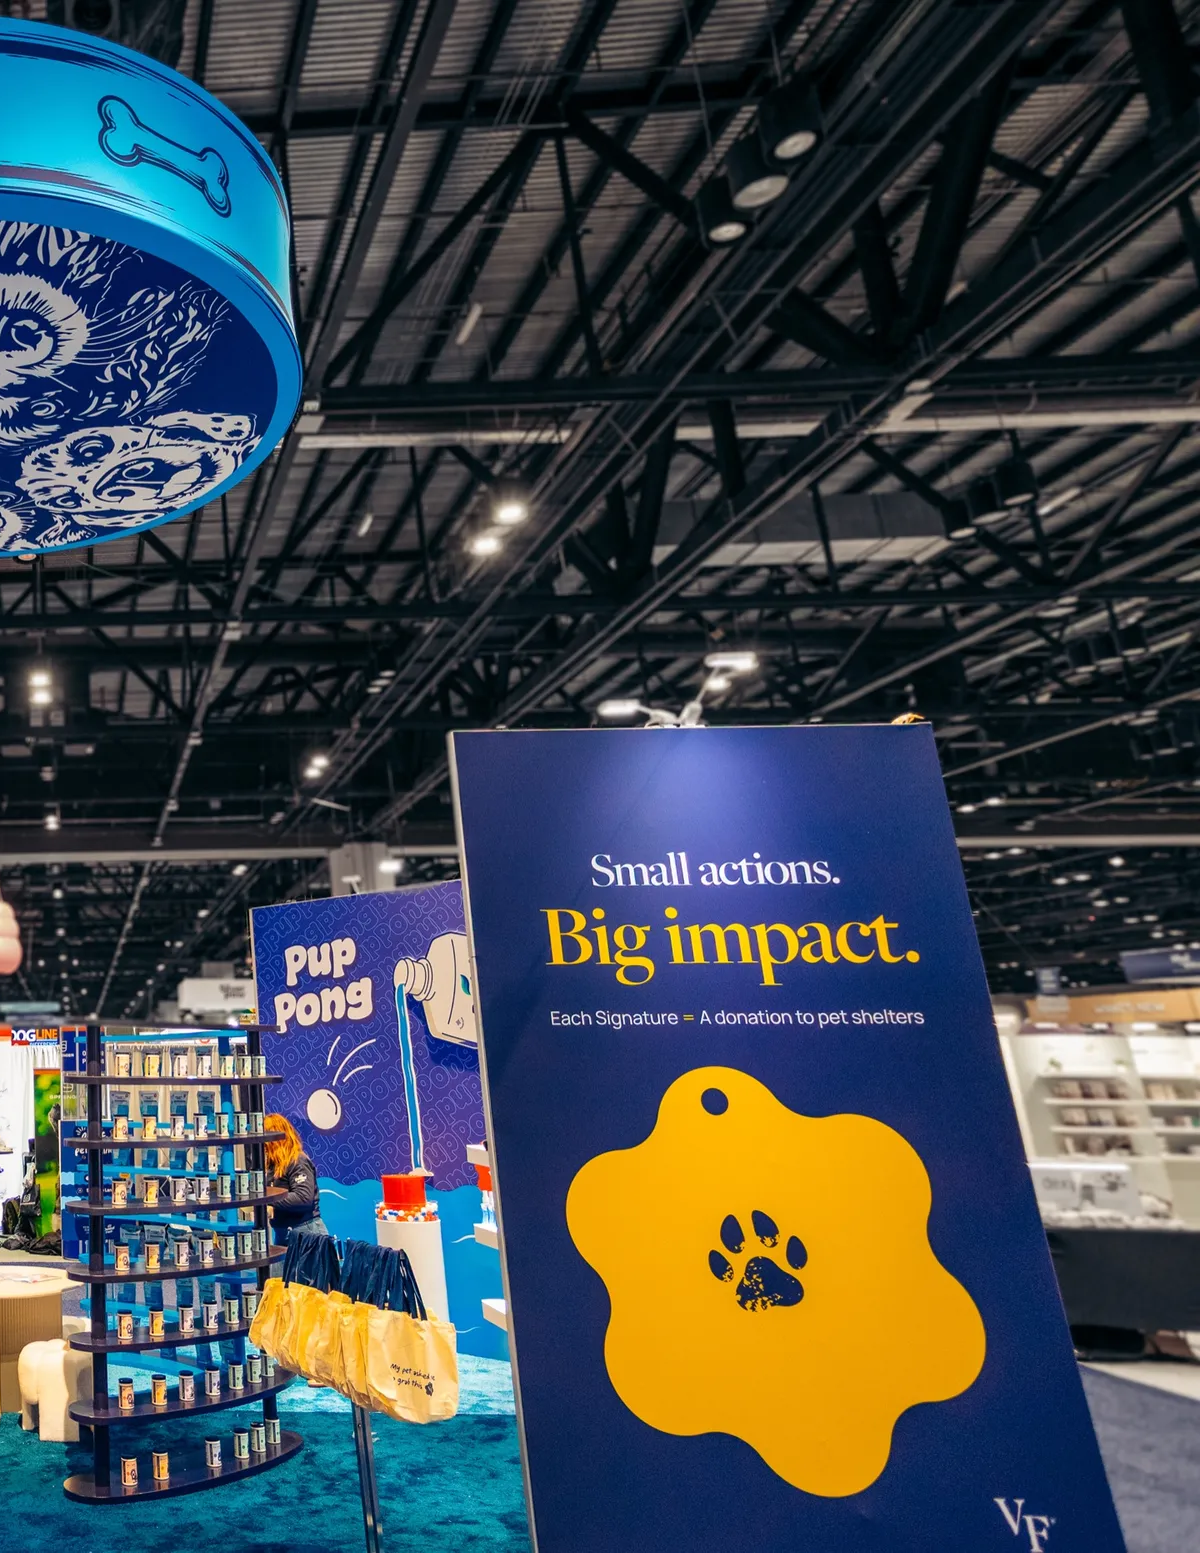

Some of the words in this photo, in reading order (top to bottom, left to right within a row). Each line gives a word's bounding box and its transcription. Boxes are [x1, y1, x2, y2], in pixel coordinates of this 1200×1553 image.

[591, 851, 693, 888] Small
[698, 852, 841, 887] actions.
[540, 907, 656, 987] Big
[664, 907, 921, 987] impact.
[550, 1011, 592, 1026] Each
[595, 1009, 678, 1029] Signature
[700, 1011, 712, 1025] A
[714, 1009, 792, 1025] donation
[795, 1011, 814, 1025] to
[819, 1012, 848, 1028] pet
[851, 1008, 925, 1025] shelters
